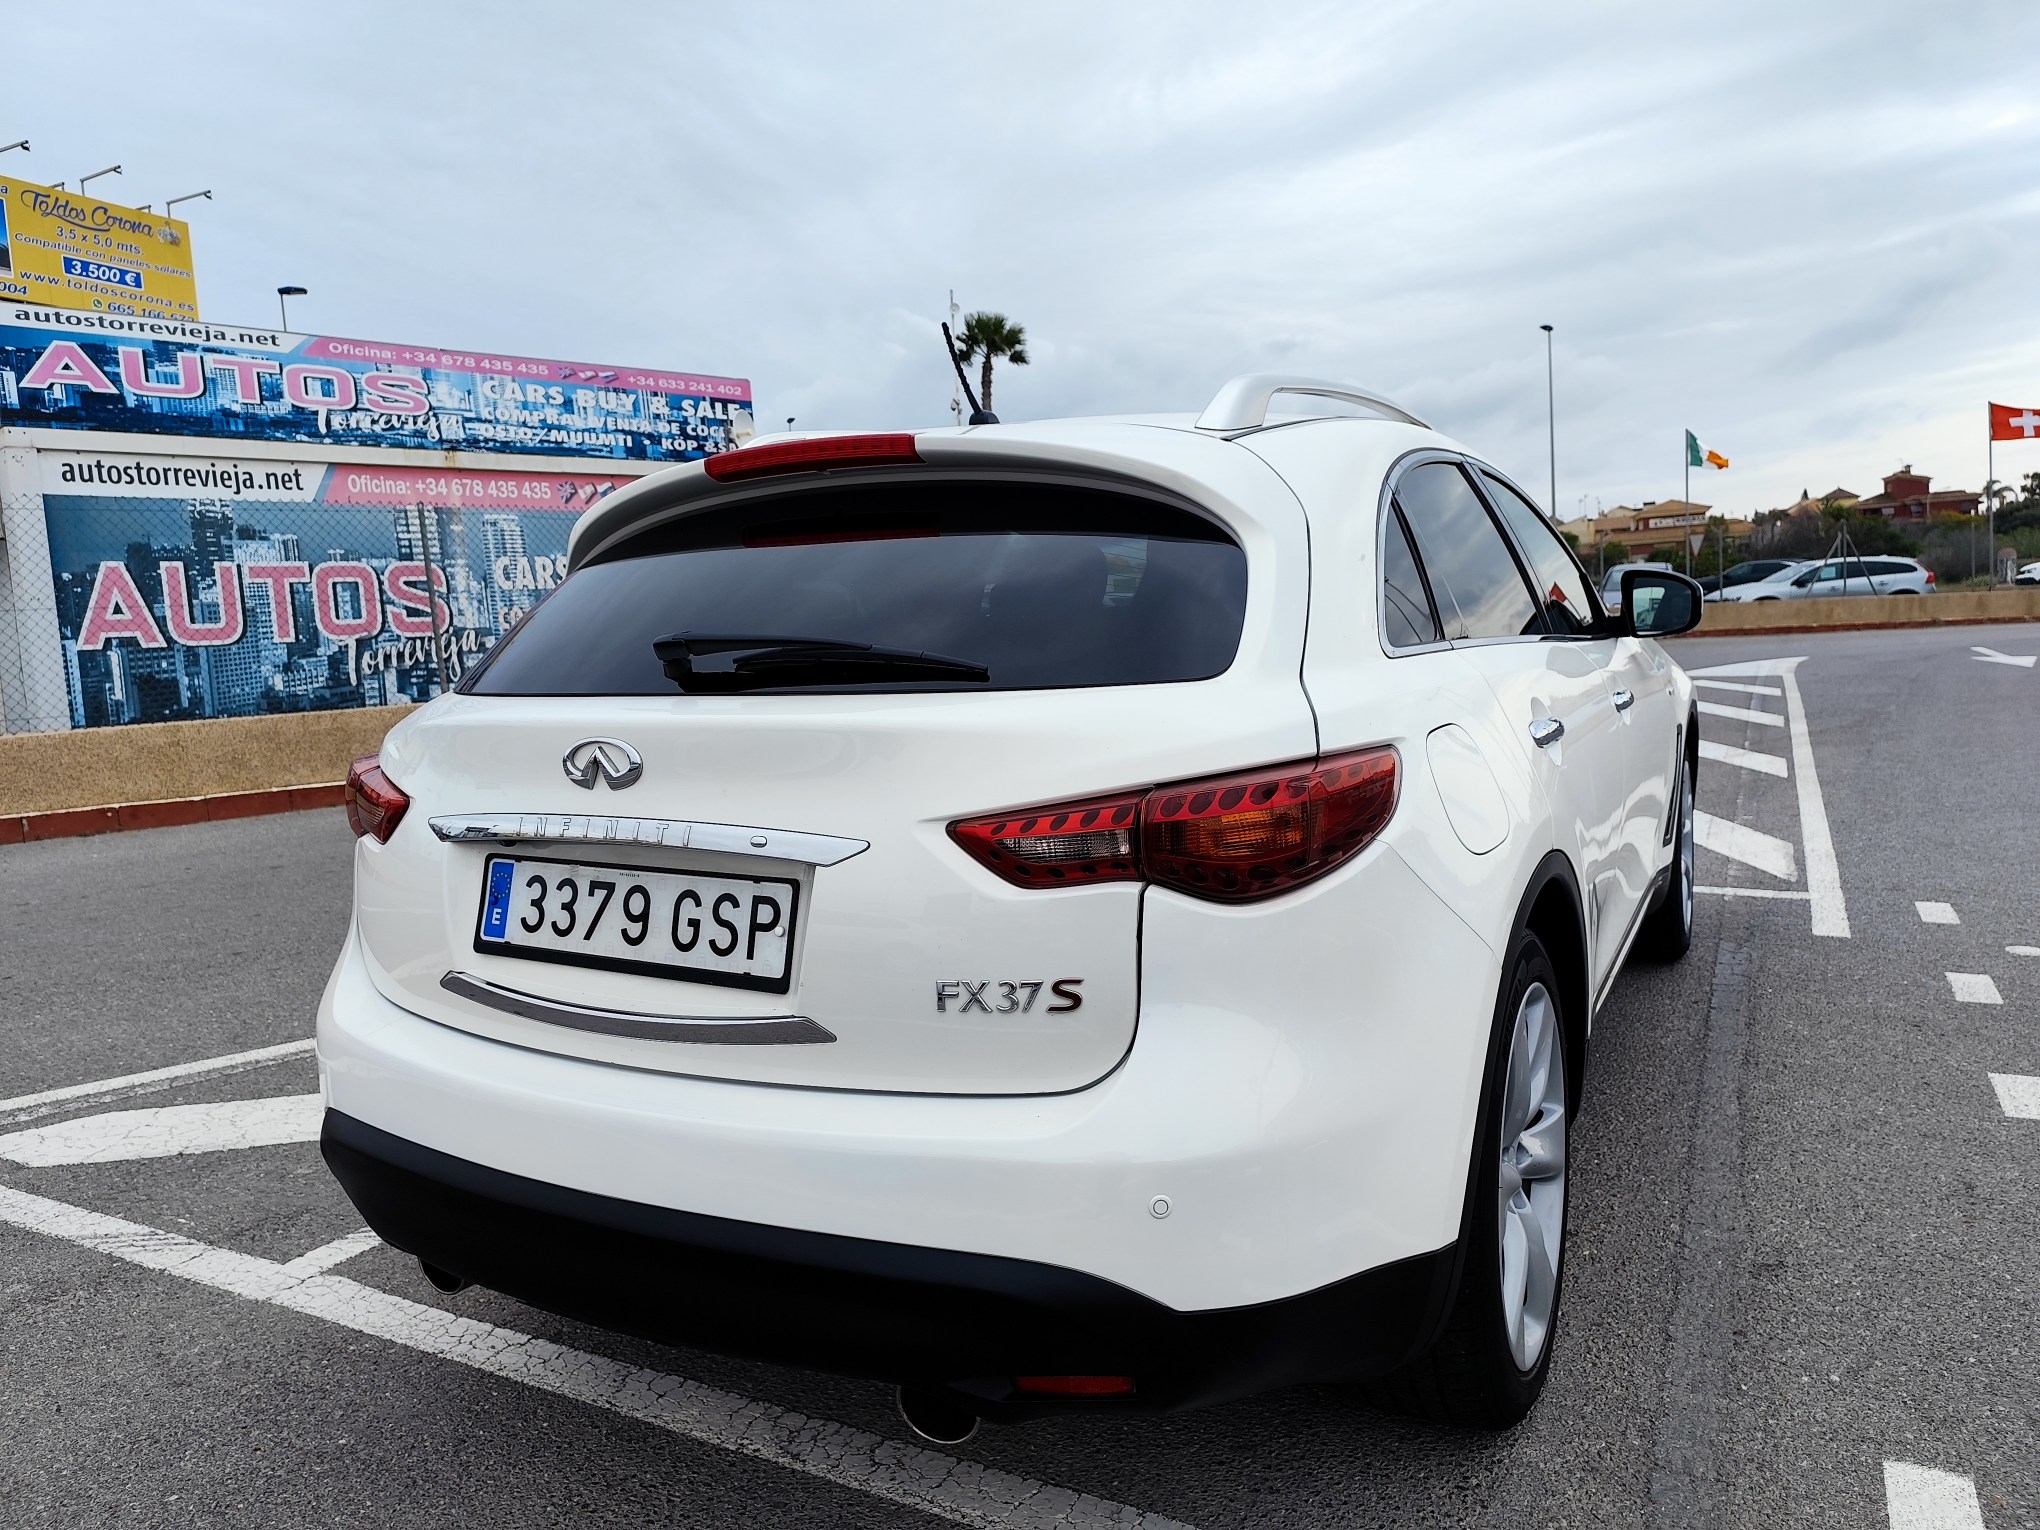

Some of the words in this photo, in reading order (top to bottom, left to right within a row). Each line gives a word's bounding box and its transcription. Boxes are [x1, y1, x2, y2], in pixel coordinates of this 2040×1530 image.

[20, 189, 88, 224] Toldos
[91, 206, 154, 238] Corona
[14, 233, 82, 255] Compatible
[85, 250, 106, 260] con
[109, 254, 151, 270] paneles
[154, 265, 191, 279] solares
[56, 226, 76, 240] 3,5
[81, 234, 88, 243] x
[93, 234, 112, 248] 5,0
[117, 242, 145, 256] mts.
[19, 270, 195, 312] www.toldoscorona.es
[70, 260, 121, 283] 3.500
[125, 272, 138, 287] €
[14, 307, 281, 347] autostorrevieja.net
[18, 339, 430, 416] AUTOS
[328, 342, 397, 361] Oficina:
[402, 350, 437, 364] +34
[441, 354, 477, 369] 678
[480, 358, 513, 372] 435
[517, 362, 549, 376] 435
[627, 374, 656, 387] +34
[658, 377, 686, 390] 633
[688, 381, 715, 393] 241
[717, 384, 743, 396] 402
[482, 380, 565, 406] CARS
[576, 388, 638, 412] BUY
[651, 395, 671, 416] &
[308, 407, 465, 442] Torrevieja
[658, 422, 681, 435] DE
[661, 434, 698, 452] KÖP
[61, 459, 304, 494] autostorrevieja.net
[347, 473, 411, 495] Oficina:
[415, 477, 448, 496] +34
[451, 479, 484, 498] 678
[487, 481, 518, 499] 435
[521, 482, 551, 499] 435
[76, 560, 451, 650] AUTOS
[331, 628, 481, 687] Torrevieja
[516, 816, 692, 847] INFINITI
[491, 908, 502, 925] E
[519, 874, 652, 947] 3379
[670, 888, 782, 961] GSP
